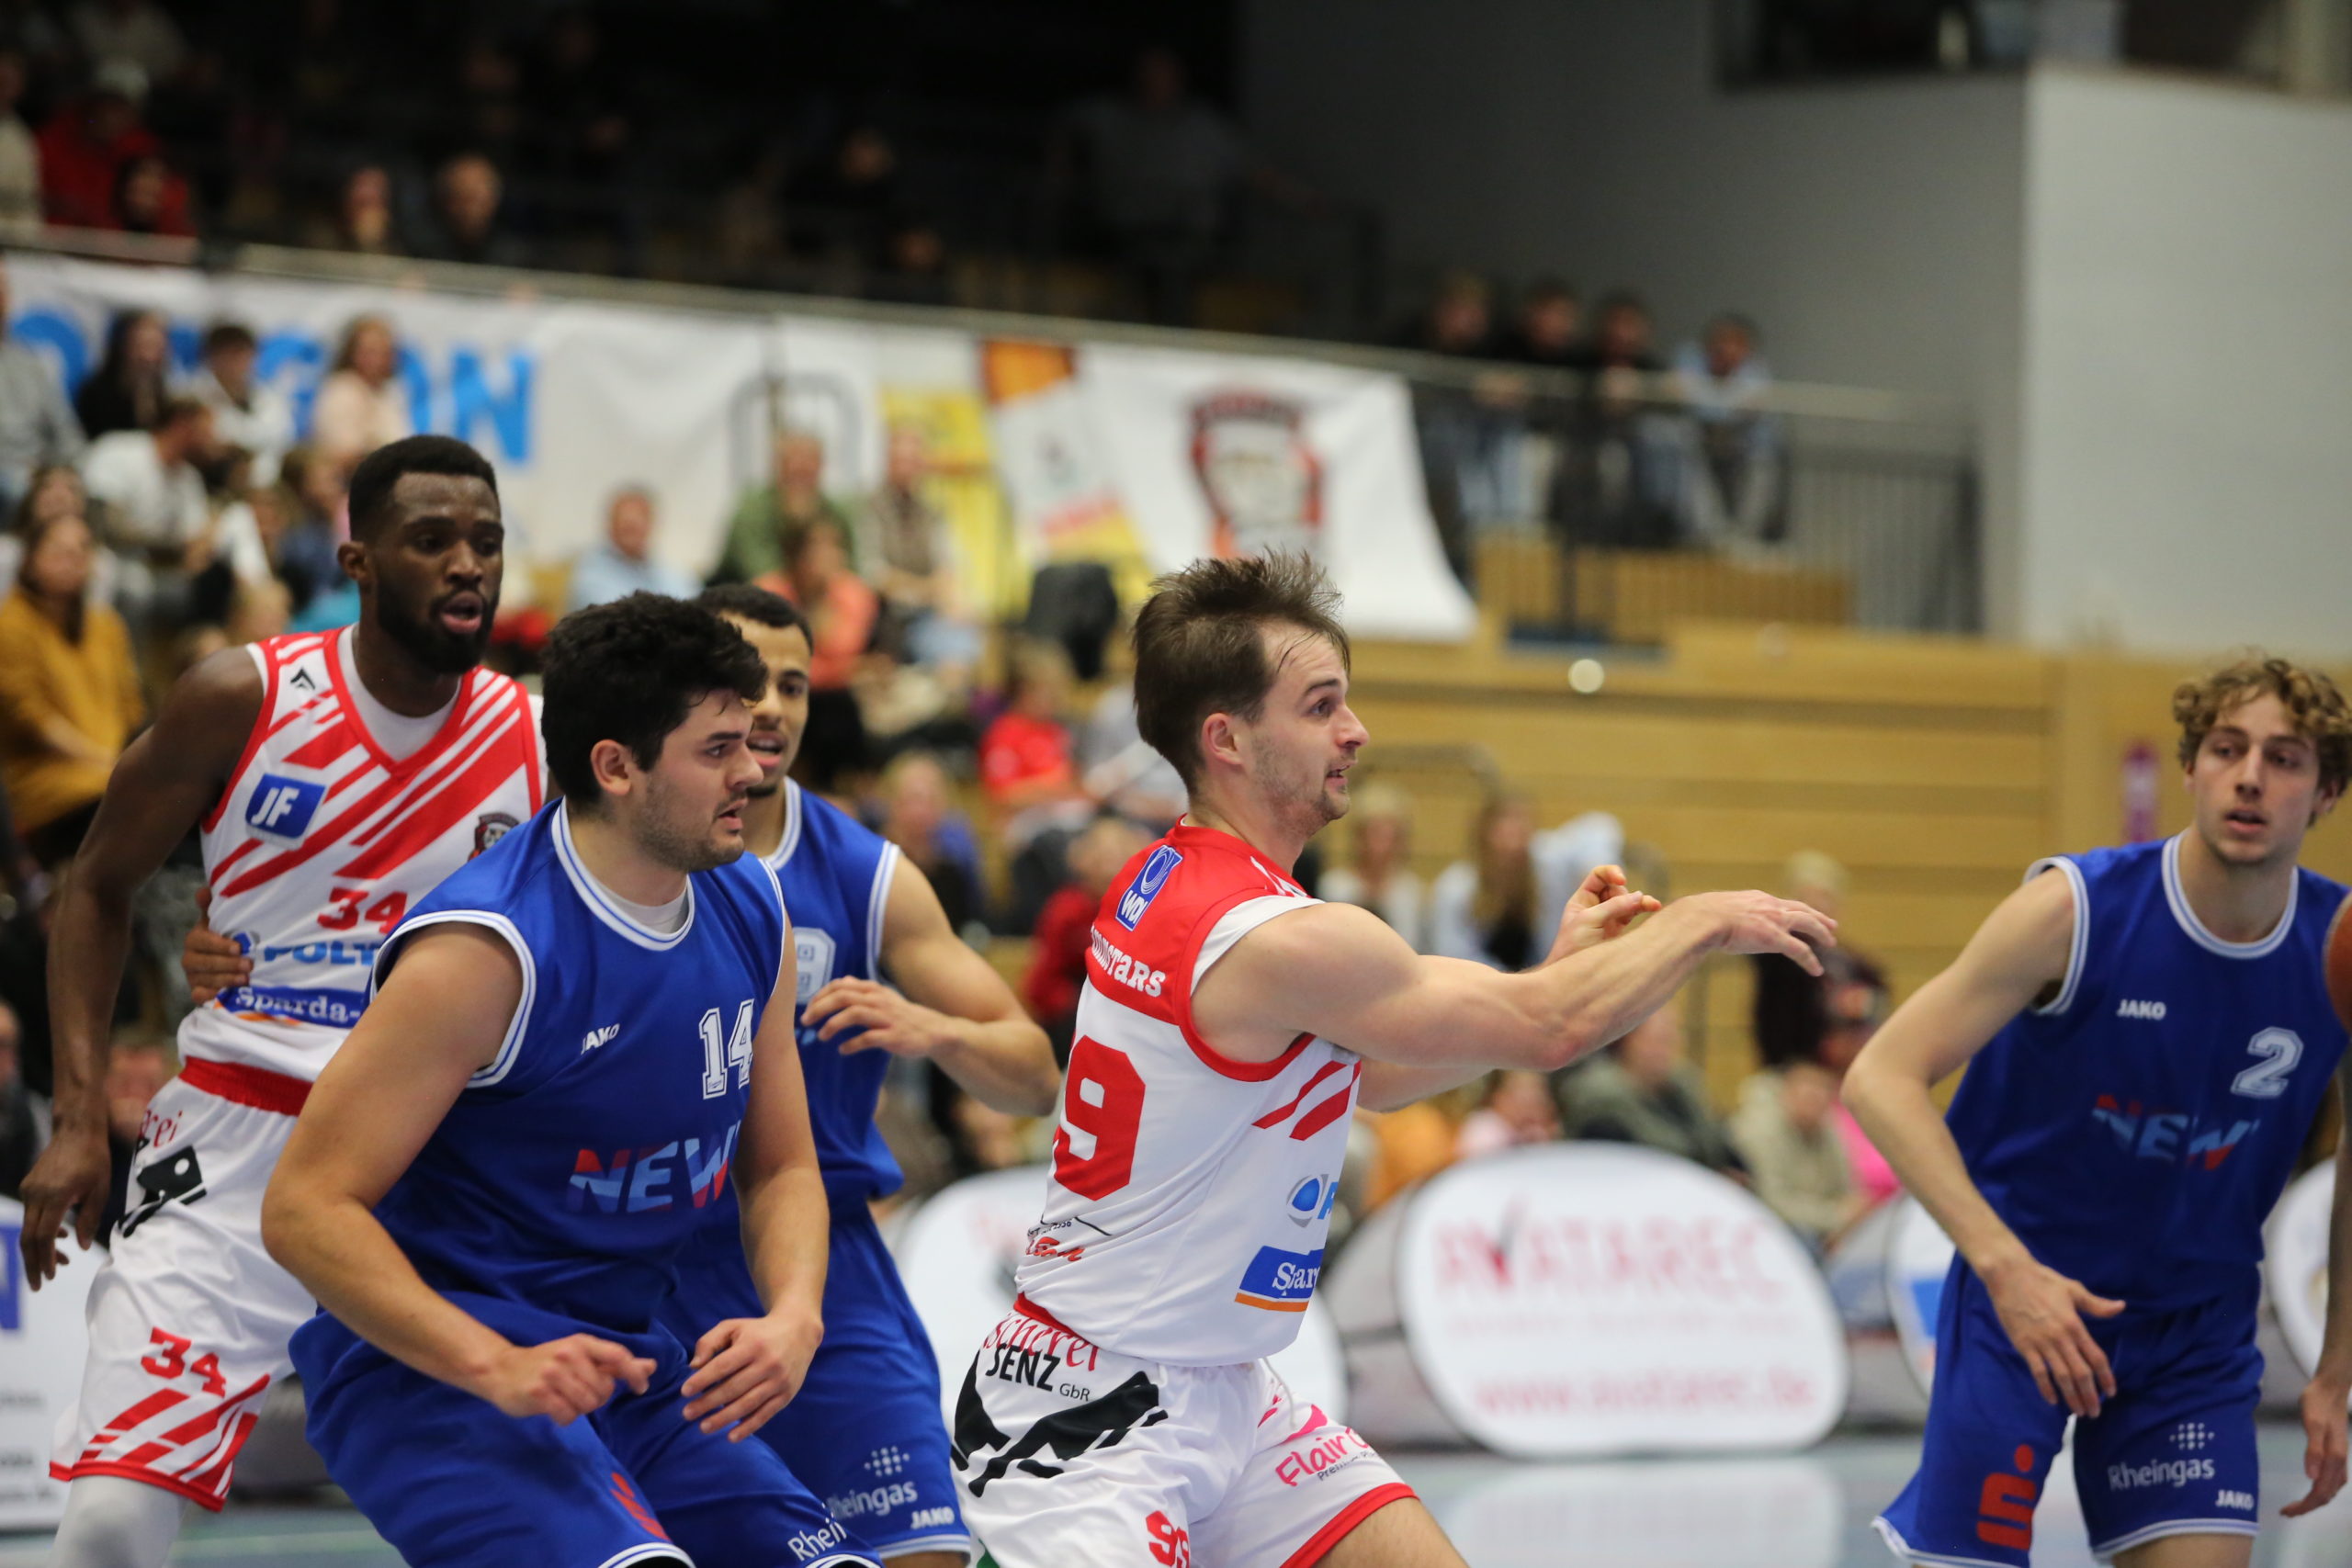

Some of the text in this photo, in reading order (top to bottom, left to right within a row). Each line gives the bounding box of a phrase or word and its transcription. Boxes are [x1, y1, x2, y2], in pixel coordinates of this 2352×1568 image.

[251, 785, 300, 827] JF
[317, 886, 408, 935] 34
[1120, 889, 1149, 925] WDI
[2116, 998, 2167, 1021] JAKO
[580, 1022, 621, 1055] JAKO
[698, 998, 755, 1100] 14
[2230, 1025, 2304, 1100] 2
[565, 1120, 741, 1213] NEW
[141, 1326, 227, 1399] 34
[985, 1342, 1091, 1403] SENZ GbR
[1275, 1436, 1348, 1487] Flair
[2107, 1458, 2216, 1491] Rheingas
[910, 1506, 956, 1530] JAKO
[2214, 1488, 2255, 1511] JAKO
